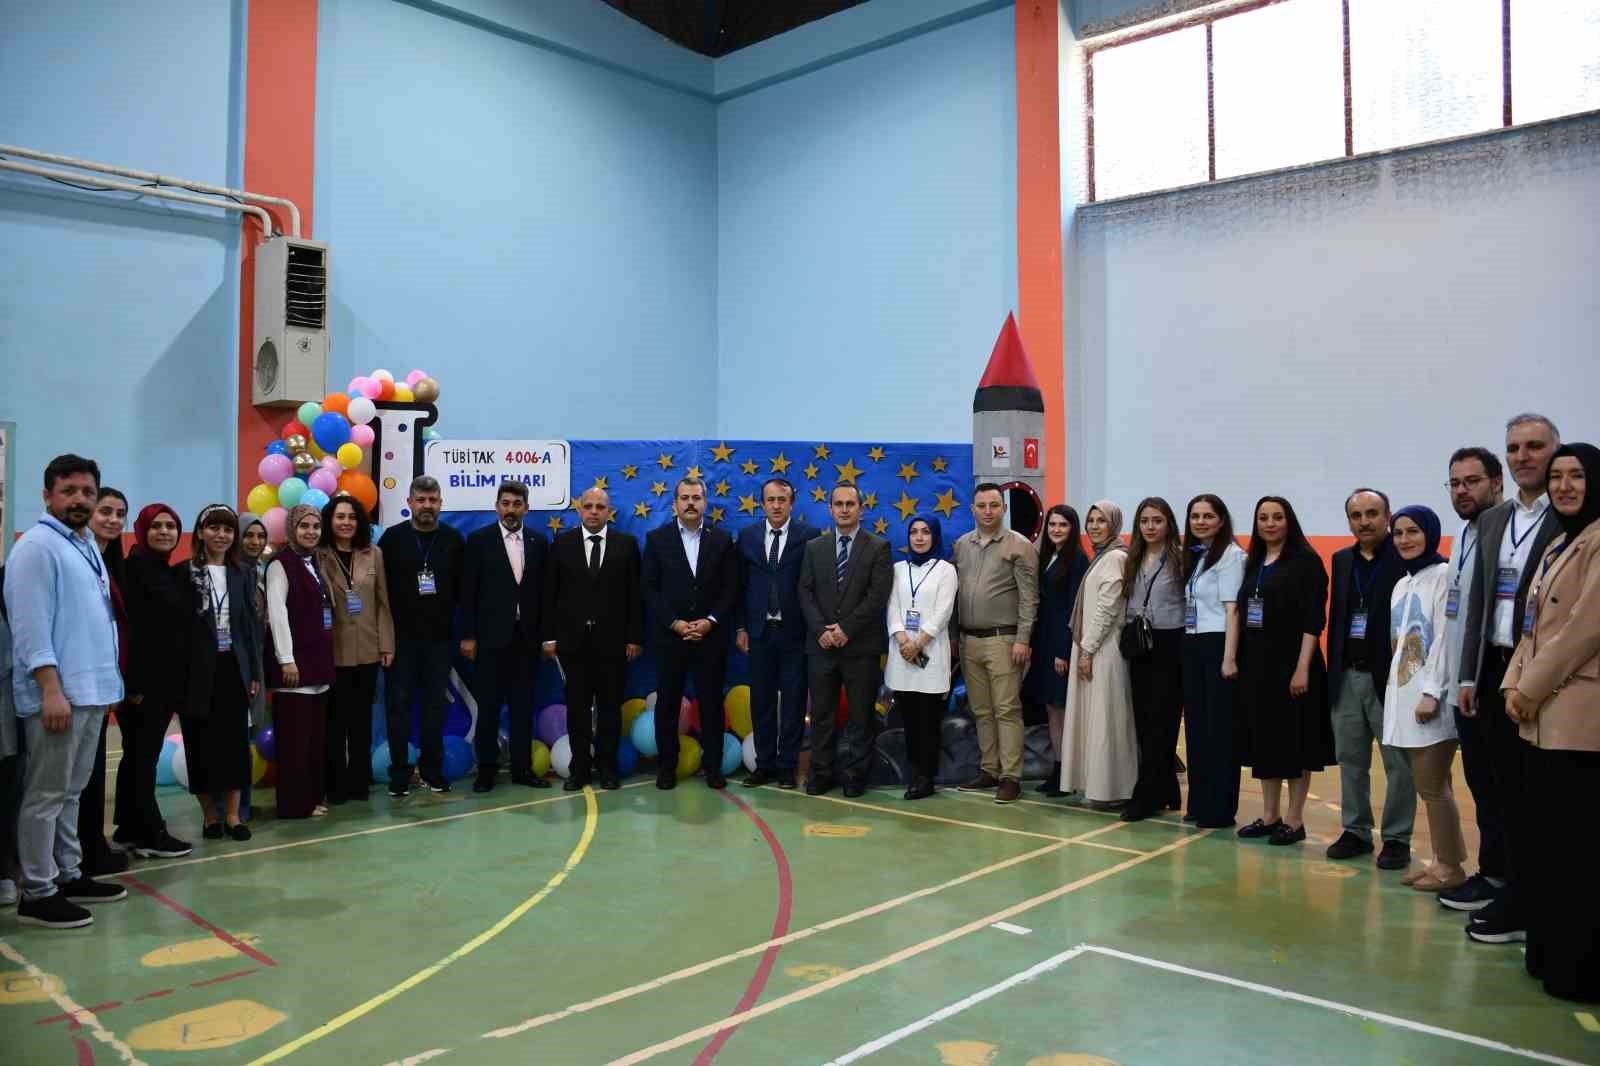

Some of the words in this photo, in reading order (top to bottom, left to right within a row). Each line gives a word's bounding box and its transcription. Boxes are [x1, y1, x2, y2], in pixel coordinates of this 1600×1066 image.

[443, 448, 495, 464] TÜBİTAK
[505, 451, 551, 464] 4006-A
[449, 470, 496, 487] BİLİM
